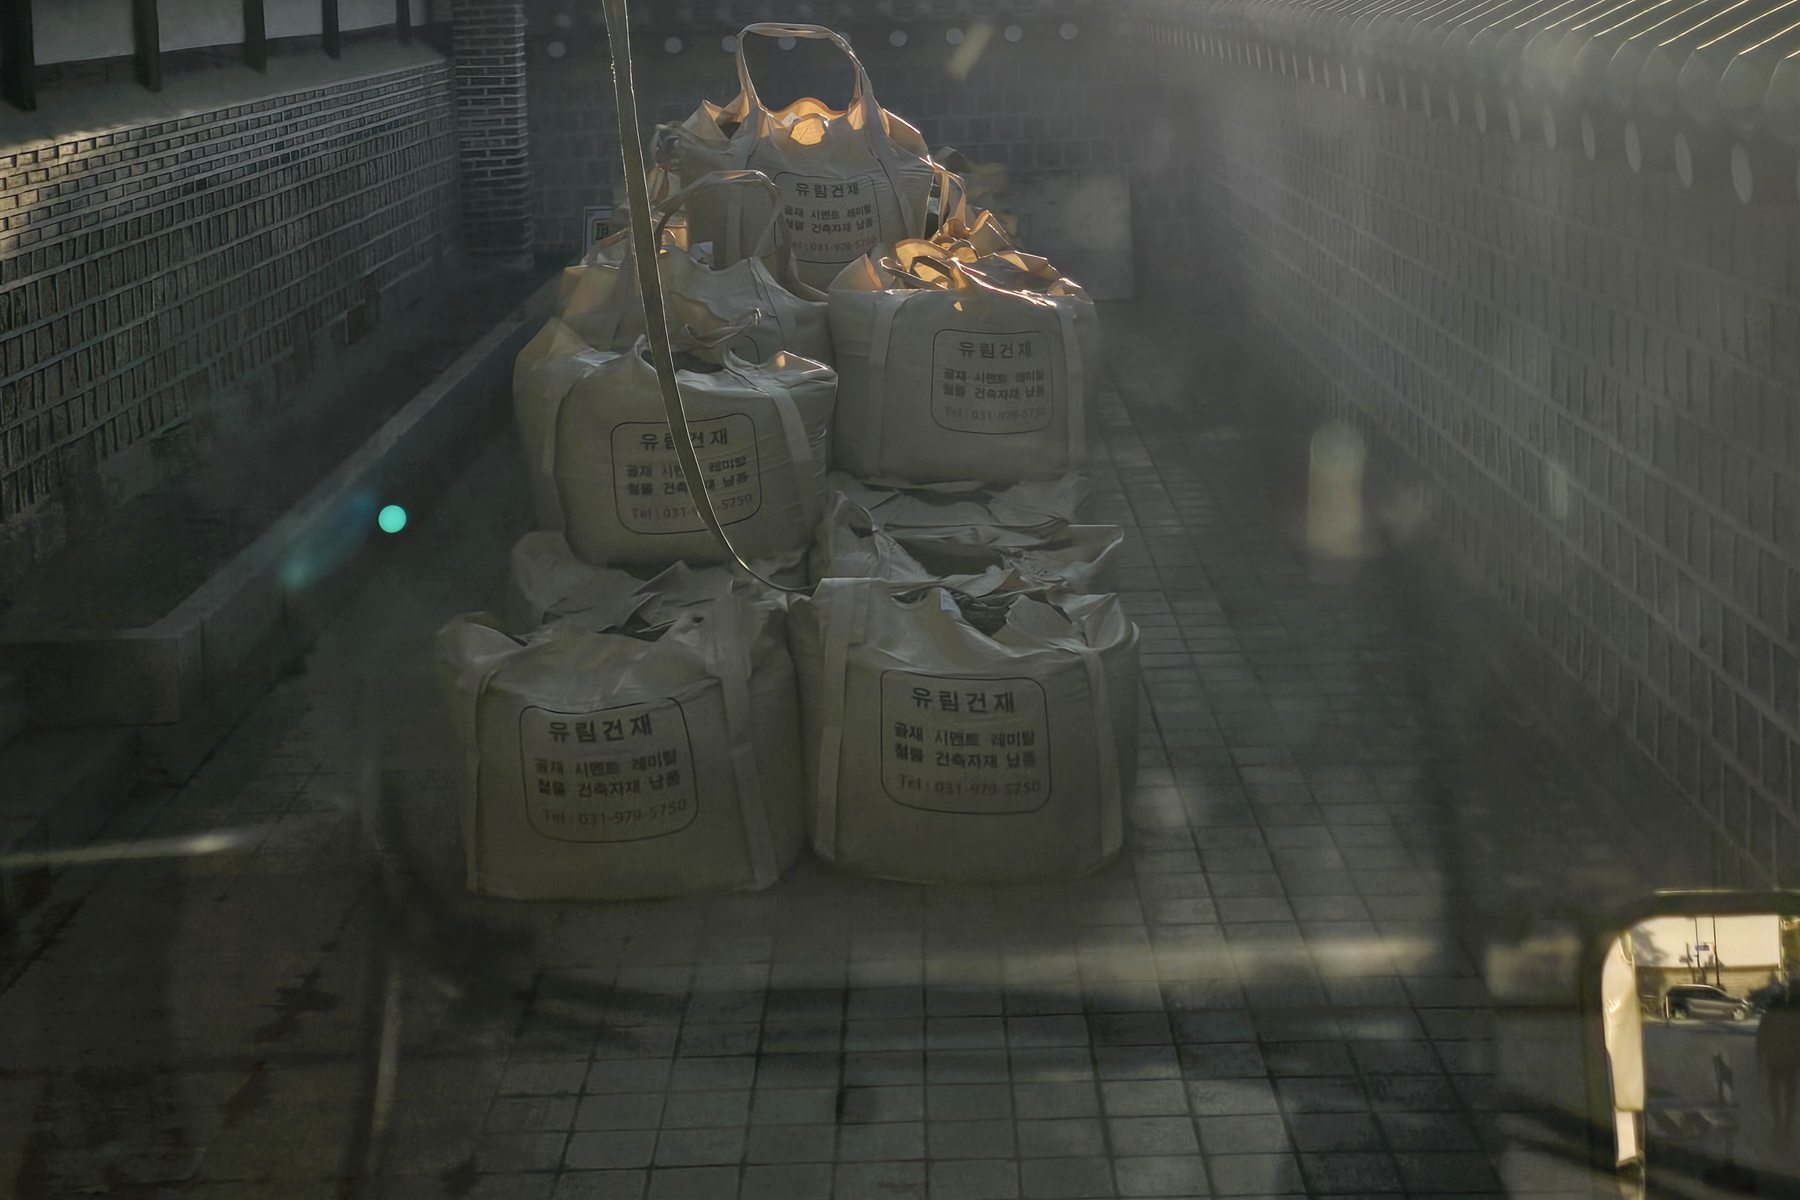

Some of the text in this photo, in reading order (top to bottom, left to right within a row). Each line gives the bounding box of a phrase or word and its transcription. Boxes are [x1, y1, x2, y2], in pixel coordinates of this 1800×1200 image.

[796, 182, 859, 198] 유림건재
[958, 341, 1032, 359] 유림건재
[911, 687, 1014, 713] 유림건재
[549, 712, 652, 743] 유림건재
[894, 721, 924, 742] 골재
[935, 730, 980, 747] 시멘트
[535, 758, 564, 776] 골재
[575, 761, 621, 778] 시멘트
[935, 751, 998, 769] 건축자재
[578, 779, 640, 798] 건축자재
[649, 769, 681, 791] 납품
